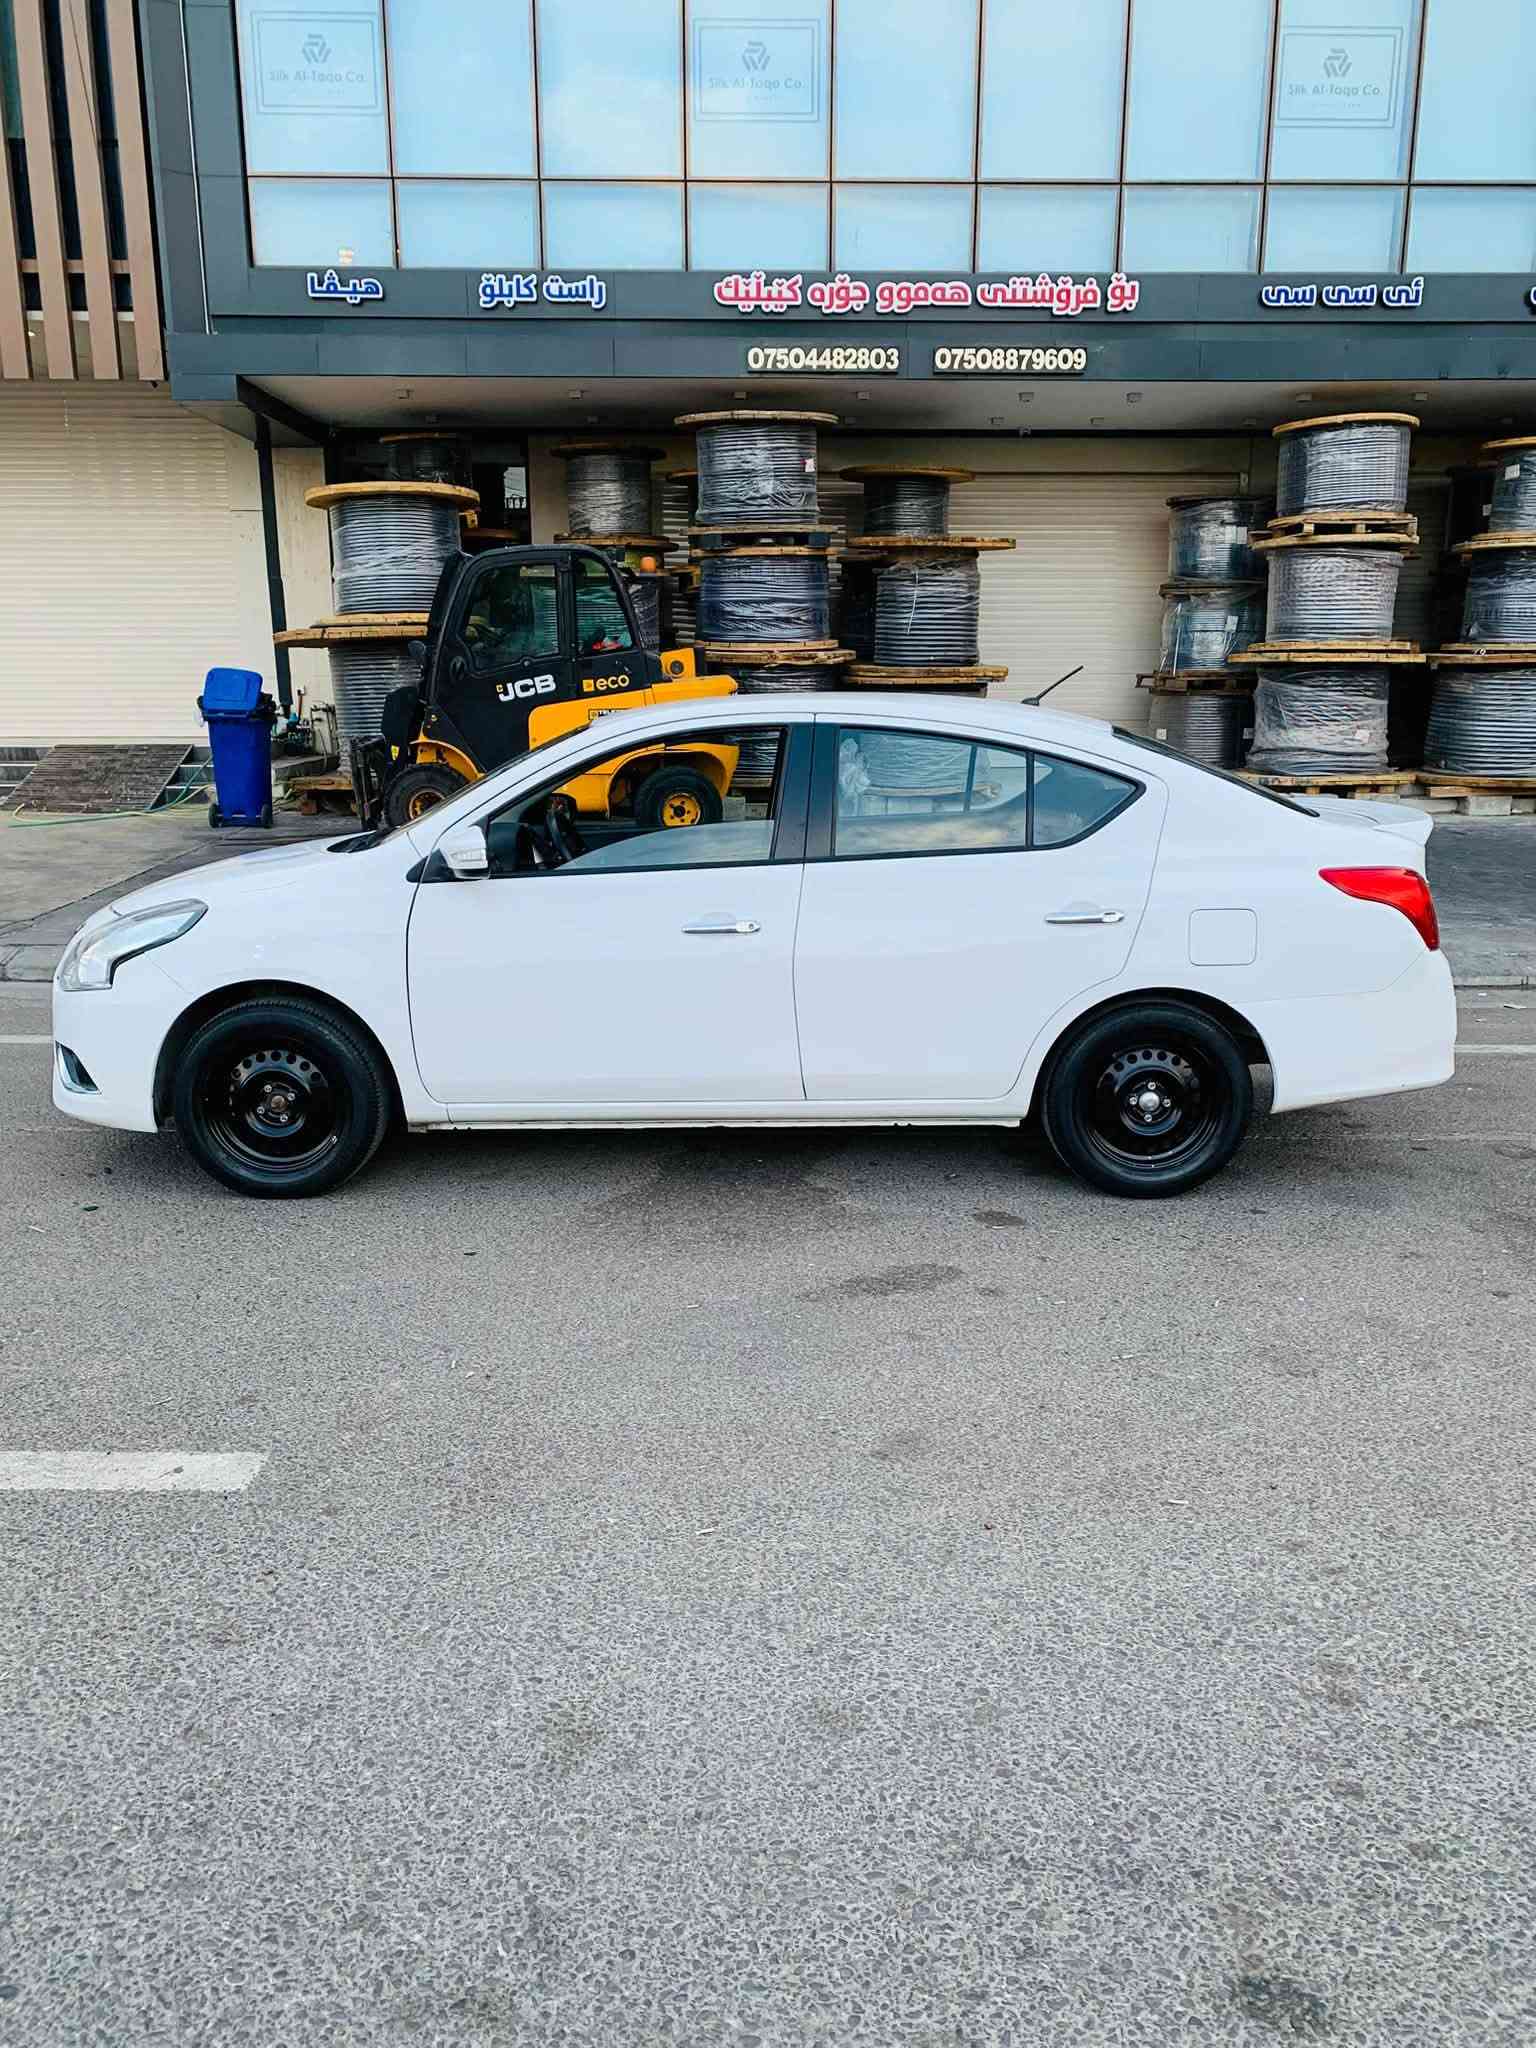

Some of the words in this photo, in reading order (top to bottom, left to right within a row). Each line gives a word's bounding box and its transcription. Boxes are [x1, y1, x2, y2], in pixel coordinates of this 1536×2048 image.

[543, 274, 606, 309] راست
[1107, 272, 1139, 310] بۆ
[748, 347, 899, 371] 07504482803
[935, 347, 1086, 371] 07508879609
[498, 674, 556, 702] JCB
[596, 674, 630, 691] eco
